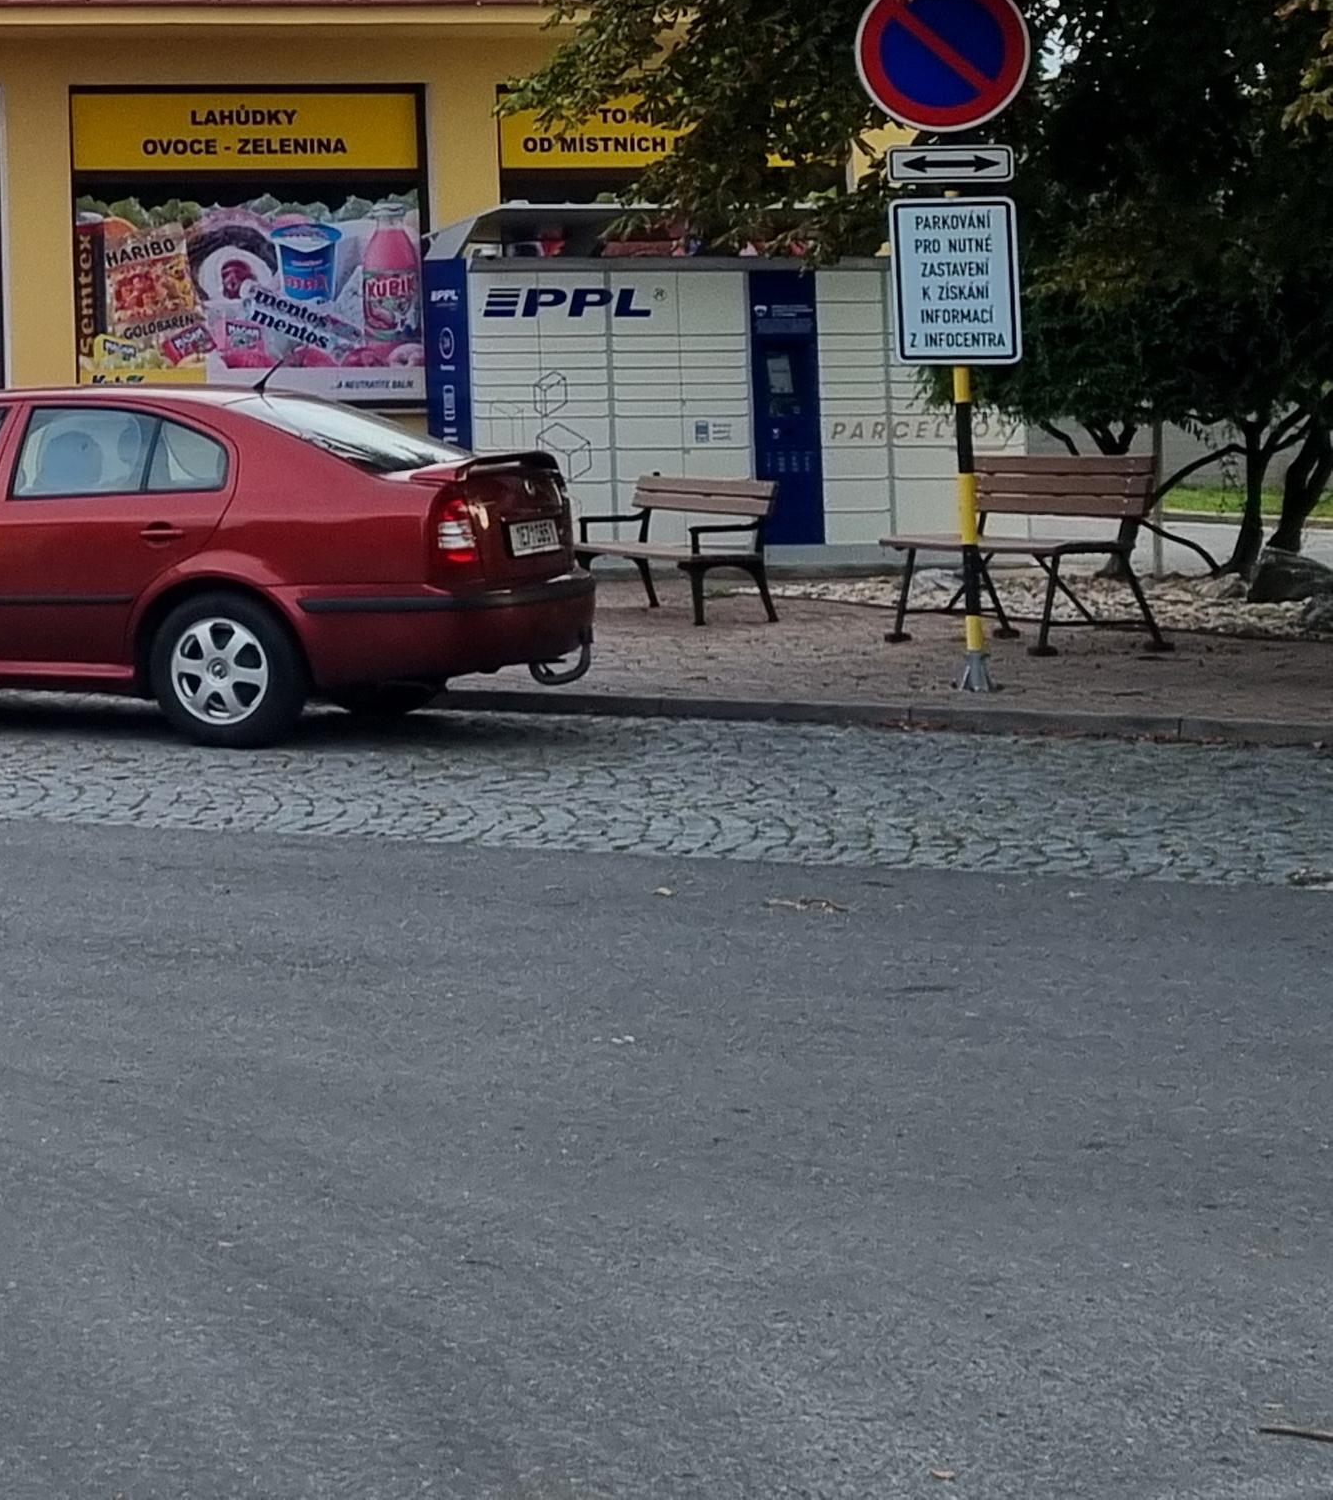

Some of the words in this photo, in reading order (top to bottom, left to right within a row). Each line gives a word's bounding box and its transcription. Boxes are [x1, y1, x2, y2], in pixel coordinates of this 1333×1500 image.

[190, 104, 298, 126] LAHŮDKY
[598, 108, 627, 124] TO
[142, 138, 218, 156] OVOCE
[237, 137, 348, 155] ZELENINA
[523, 137, 553, 153] OD
[560, 133, 667, 153] MÍSTNÍCH
[915, 210, 992, 230] PARKOVÁNÍ
[106, 238, 176, 267] HARIBO
[915, 238, 941, 254] PRO
[948, 234, 993, 253] NUTNÉ
[921, 257, 990, 277] ZASTAVENÍ
[79, 234, 94, 357] semtex
[922, 286, 932, 301] K
[938, 281, 990, 301] ZÍSKÁNÍ
[254, 289, 329, 328] mentos
[522, 287, 652, 318] PPL
[921, 304, 994, 324] INFORMACÍ
[251, 309, 330, 350] mentos
[910, 332, 918, 348] Z
[925, 331, 1006, 348] INFOCENTRA
[831, 421, 1007, 440] PARCELOX
